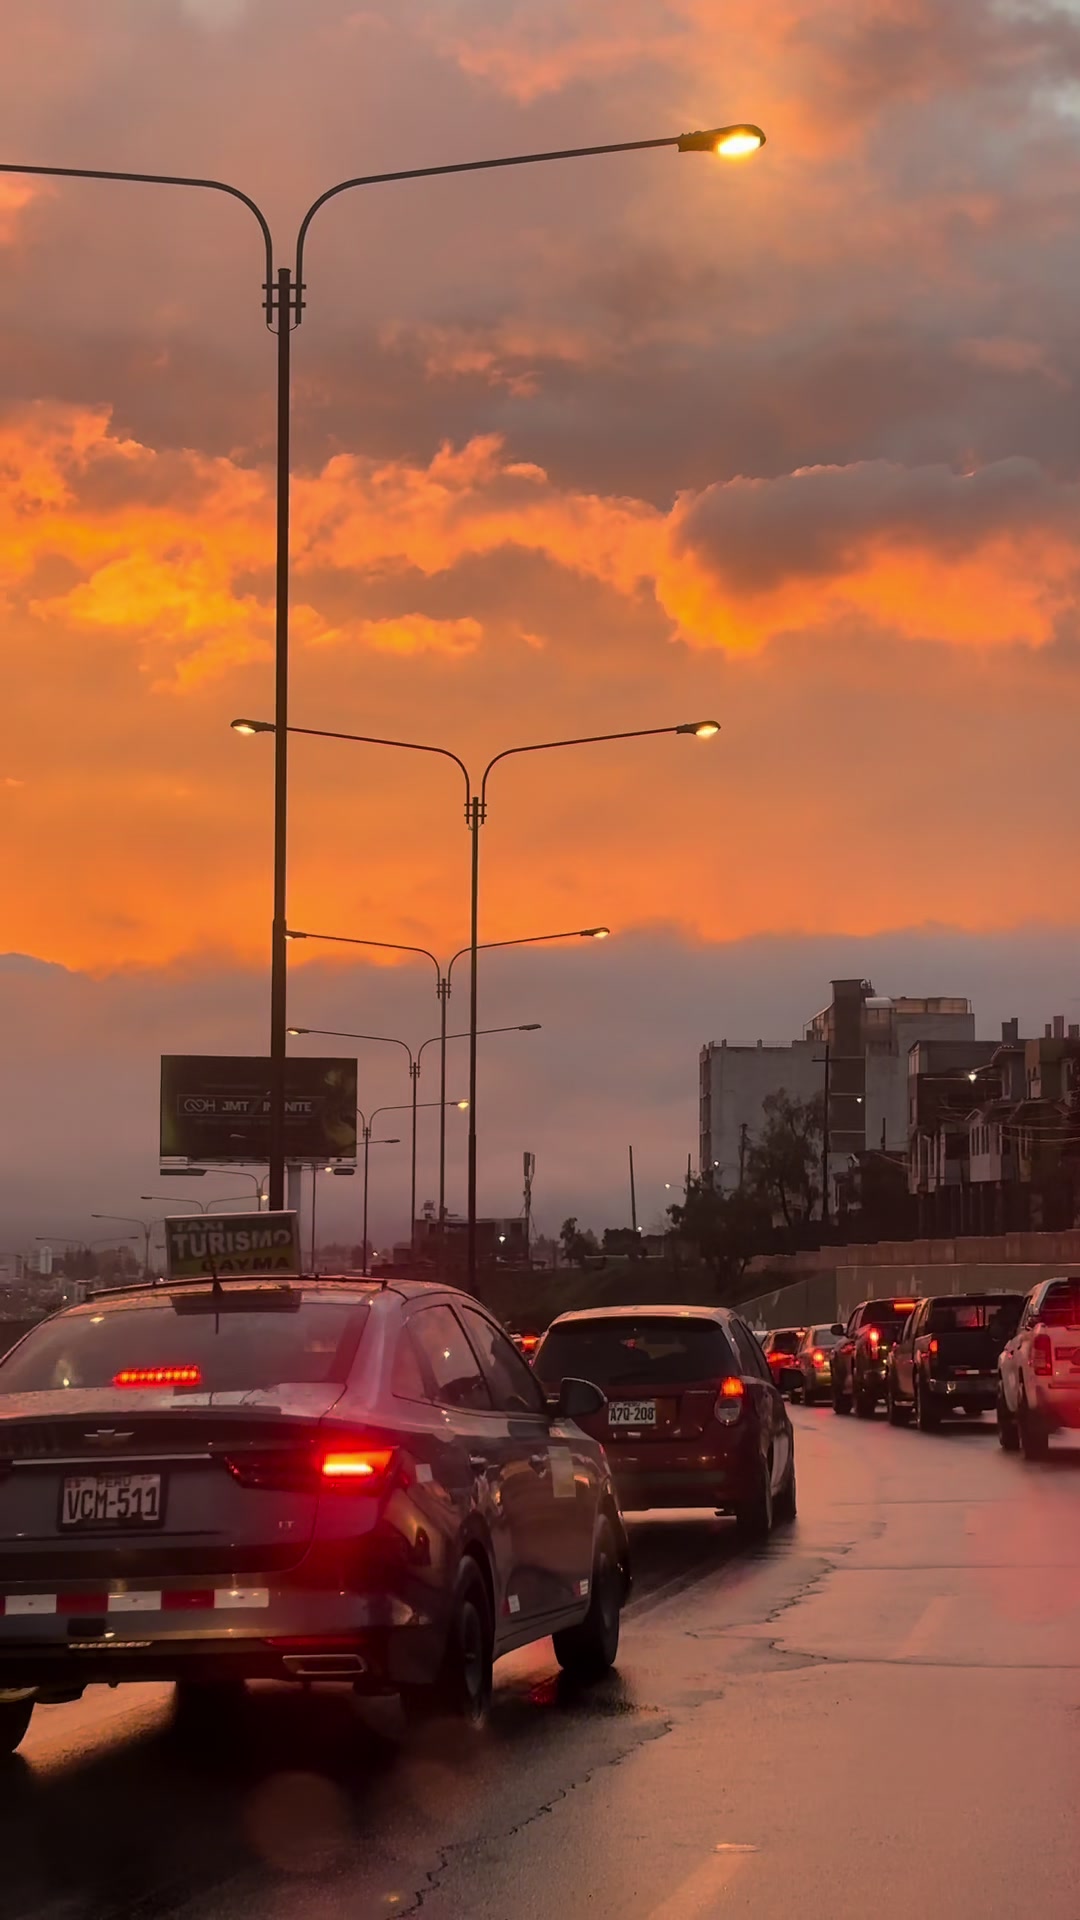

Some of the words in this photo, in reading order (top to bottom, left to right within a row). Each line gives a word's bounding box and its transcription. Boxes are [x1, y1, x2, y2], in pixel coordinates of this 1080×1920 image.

[221, 1100, 250, 1112] JMT
[174, 1221, 225, 1232] TAXI
[172, 1229, 291, 1259] TURISMO
[201, 1257, 290, 1272] CAYMA
[96, 1474, 131, 1488] PERU
[67, 1487, 158, 1520] VCM-511
